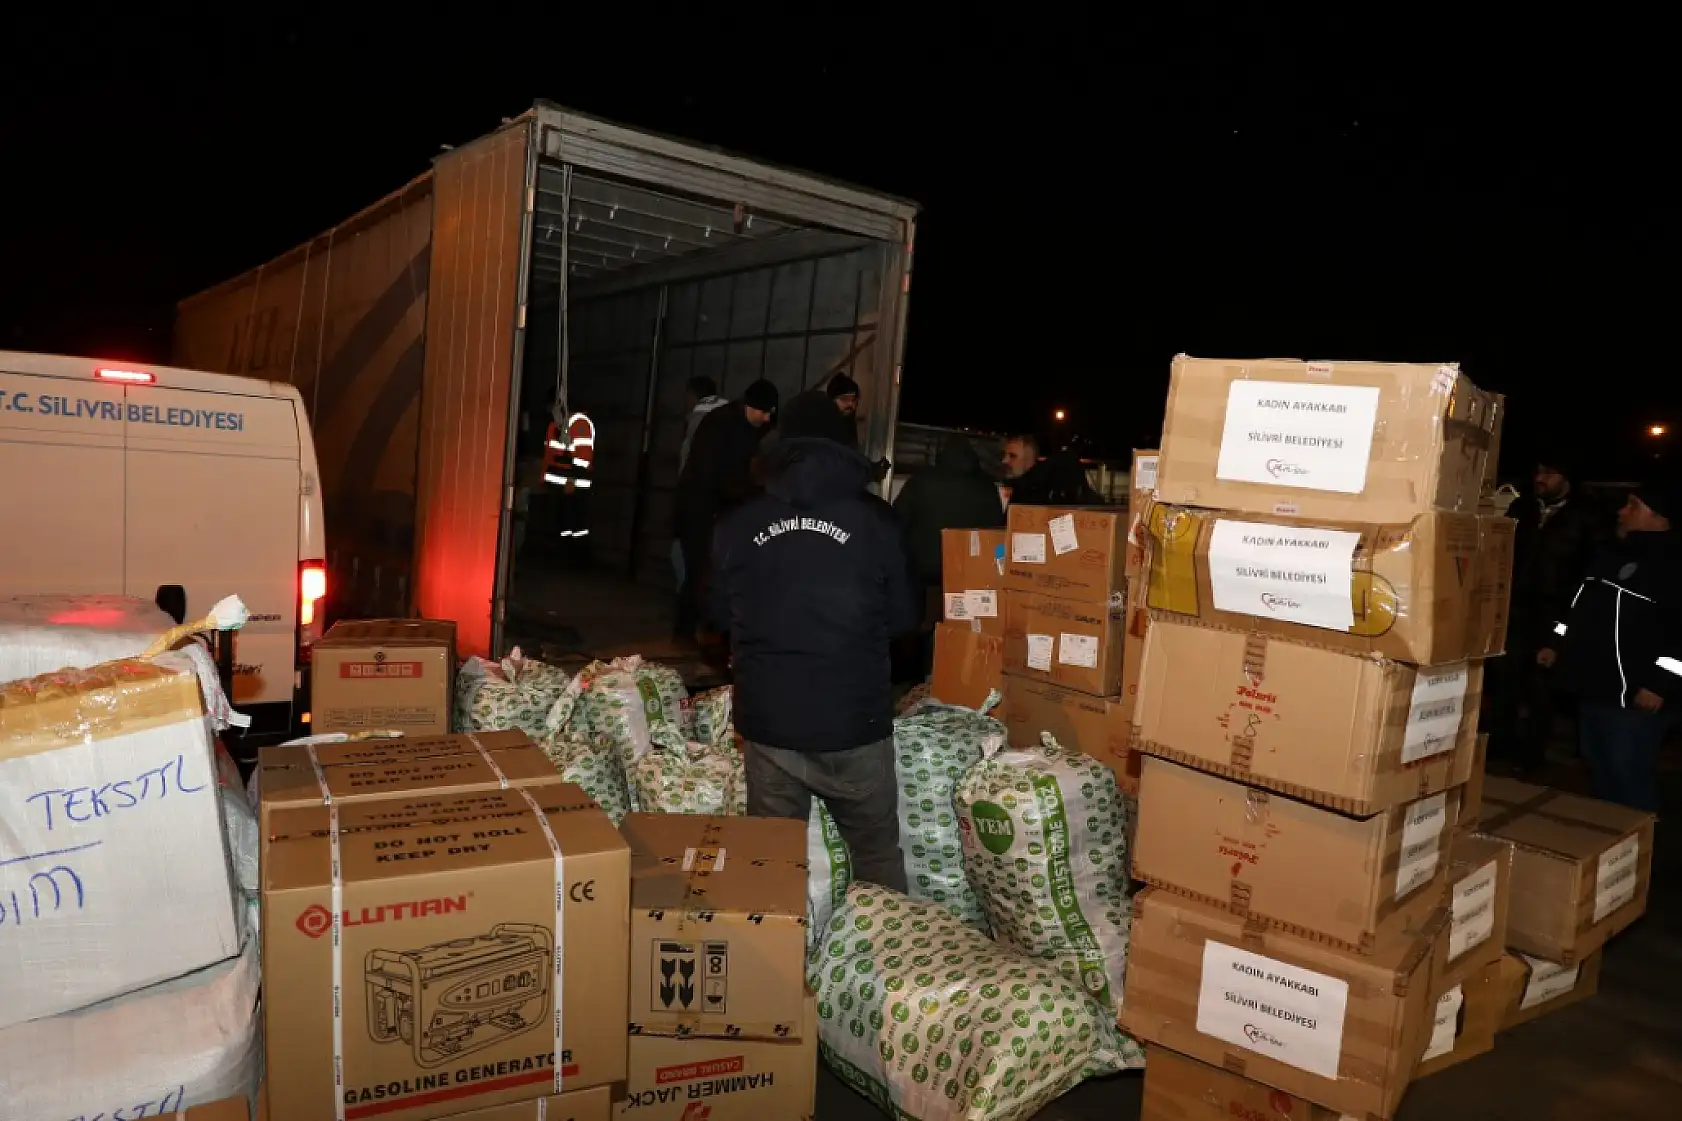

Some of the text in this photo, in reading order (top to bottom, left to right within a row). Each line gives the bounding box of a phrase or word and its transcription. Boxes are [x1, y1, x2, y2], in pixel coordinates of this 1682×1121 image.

[1257, 398, 1290, 410] KADIN
[1242, 535, 1275, 546] KADIN
[374, 827, 528, 849] DO NOT ROLL
[376, 843, 491, 862] KEEP DRY
[342, 894, 467, 927] LUTIAN
[1232, 961, 1319, 998] KADIN AYAKKABI
[343, 1071, 449, 1105] GASOLINE
[627, 1071, 774, 1109] HAMMER JACK
